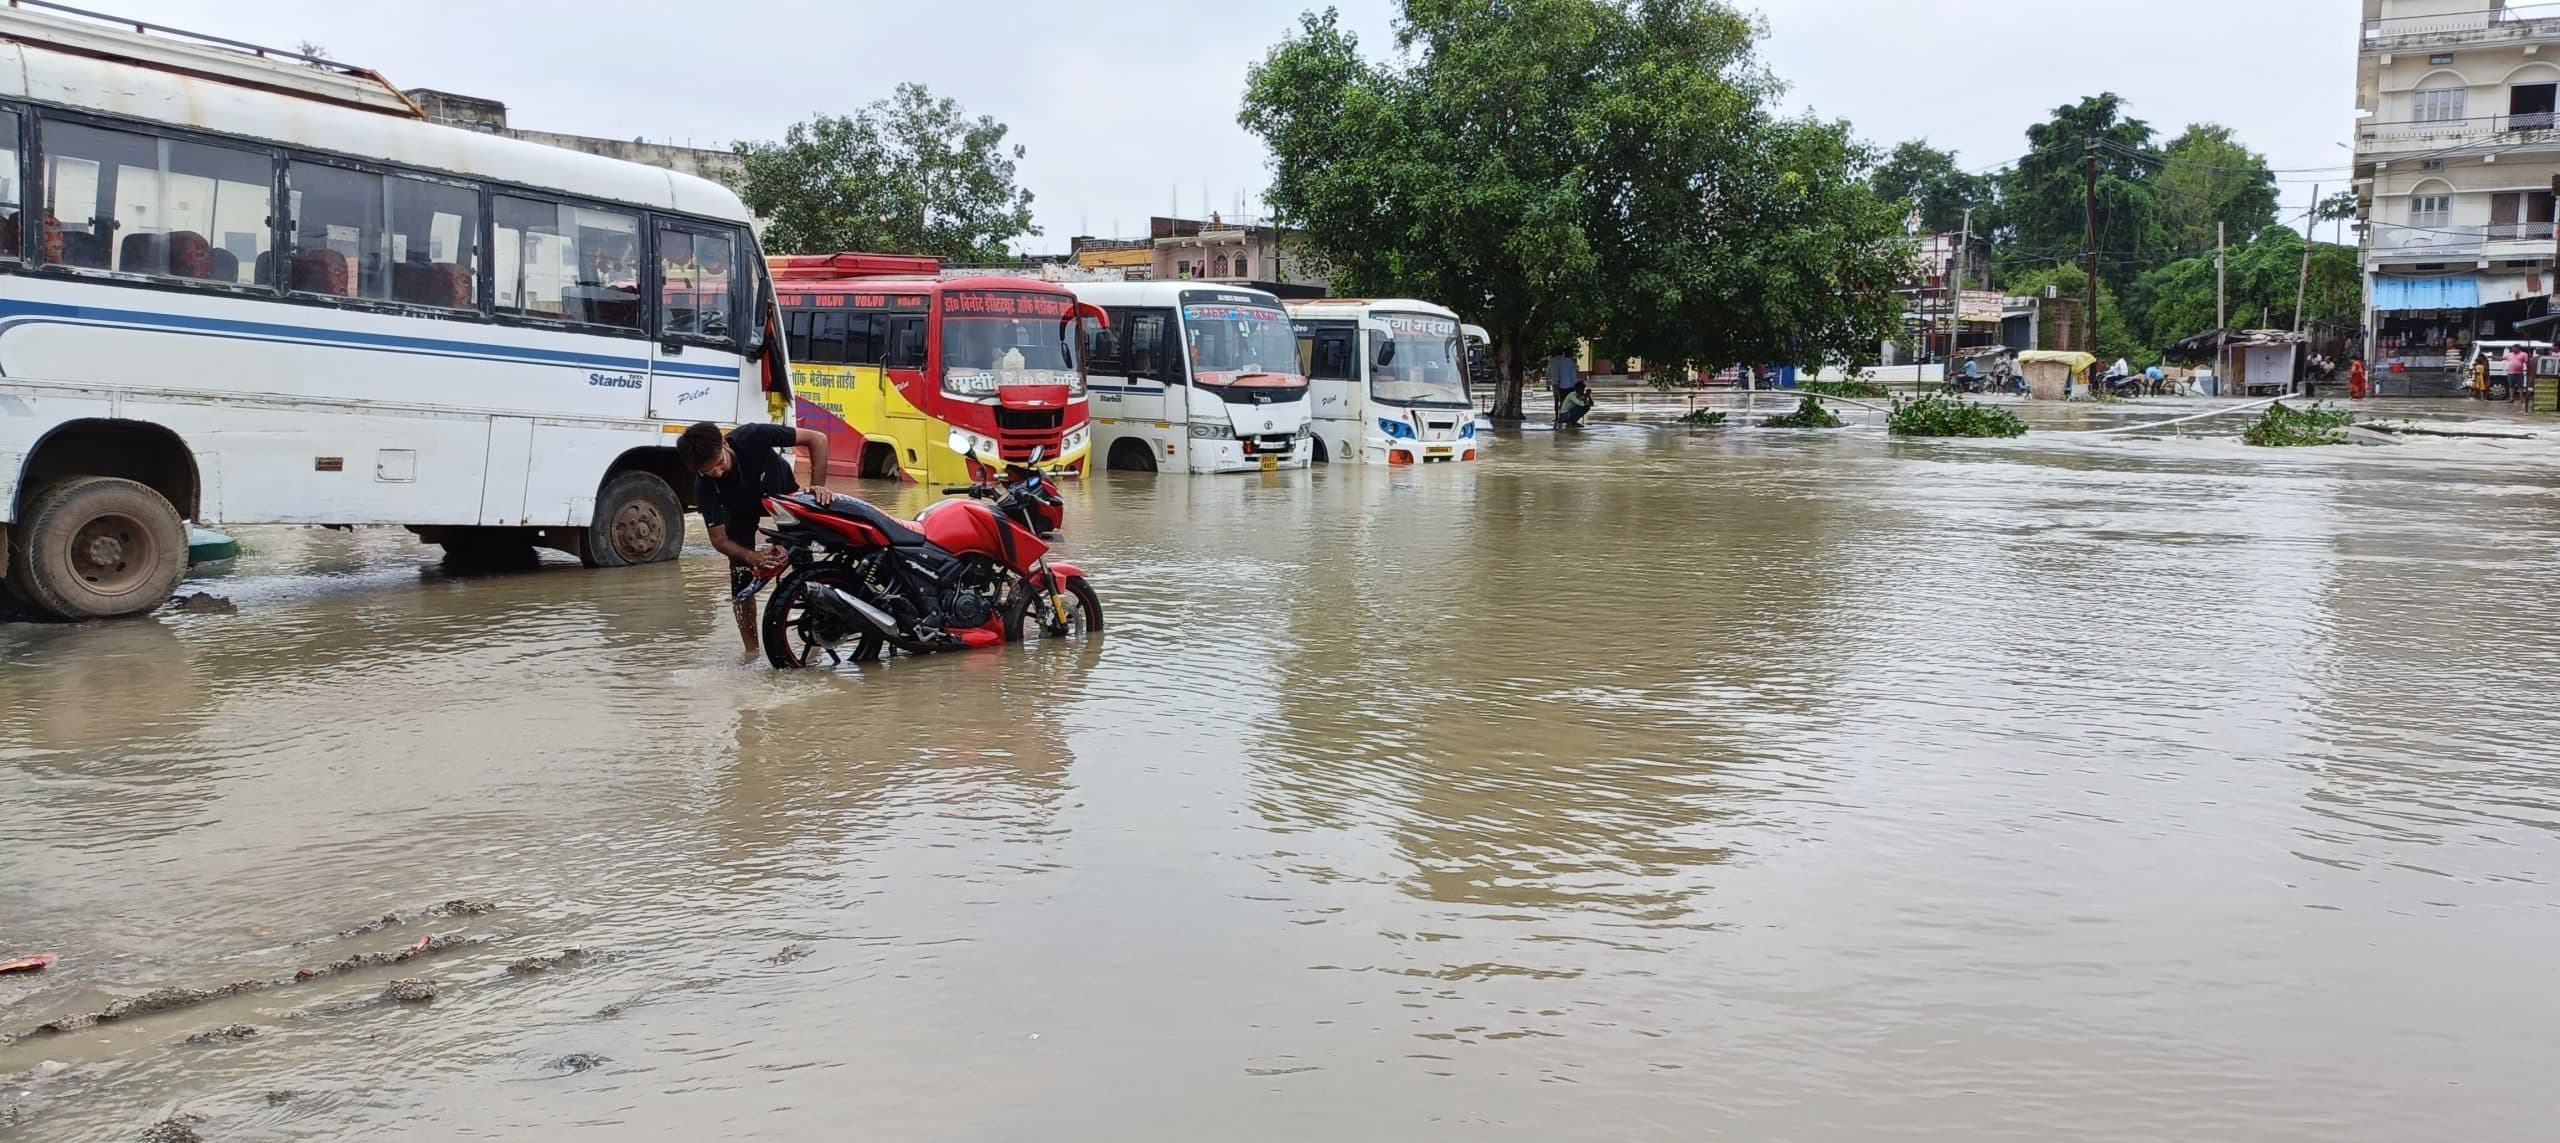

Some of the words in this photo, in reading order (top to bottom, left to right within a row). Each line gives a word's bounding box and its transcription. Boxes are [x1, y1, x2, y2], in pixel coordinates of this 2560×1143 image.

[778, 294, 801, 306] OLVO
[815, 294, 844, 307] VOLVO
[855, 295, 885, 307] VOLVO
[897, 296, 921, 306] VOLVO
[589, 373, 643, 389] Starbus
[678, 386, 710, 405] Pilot
